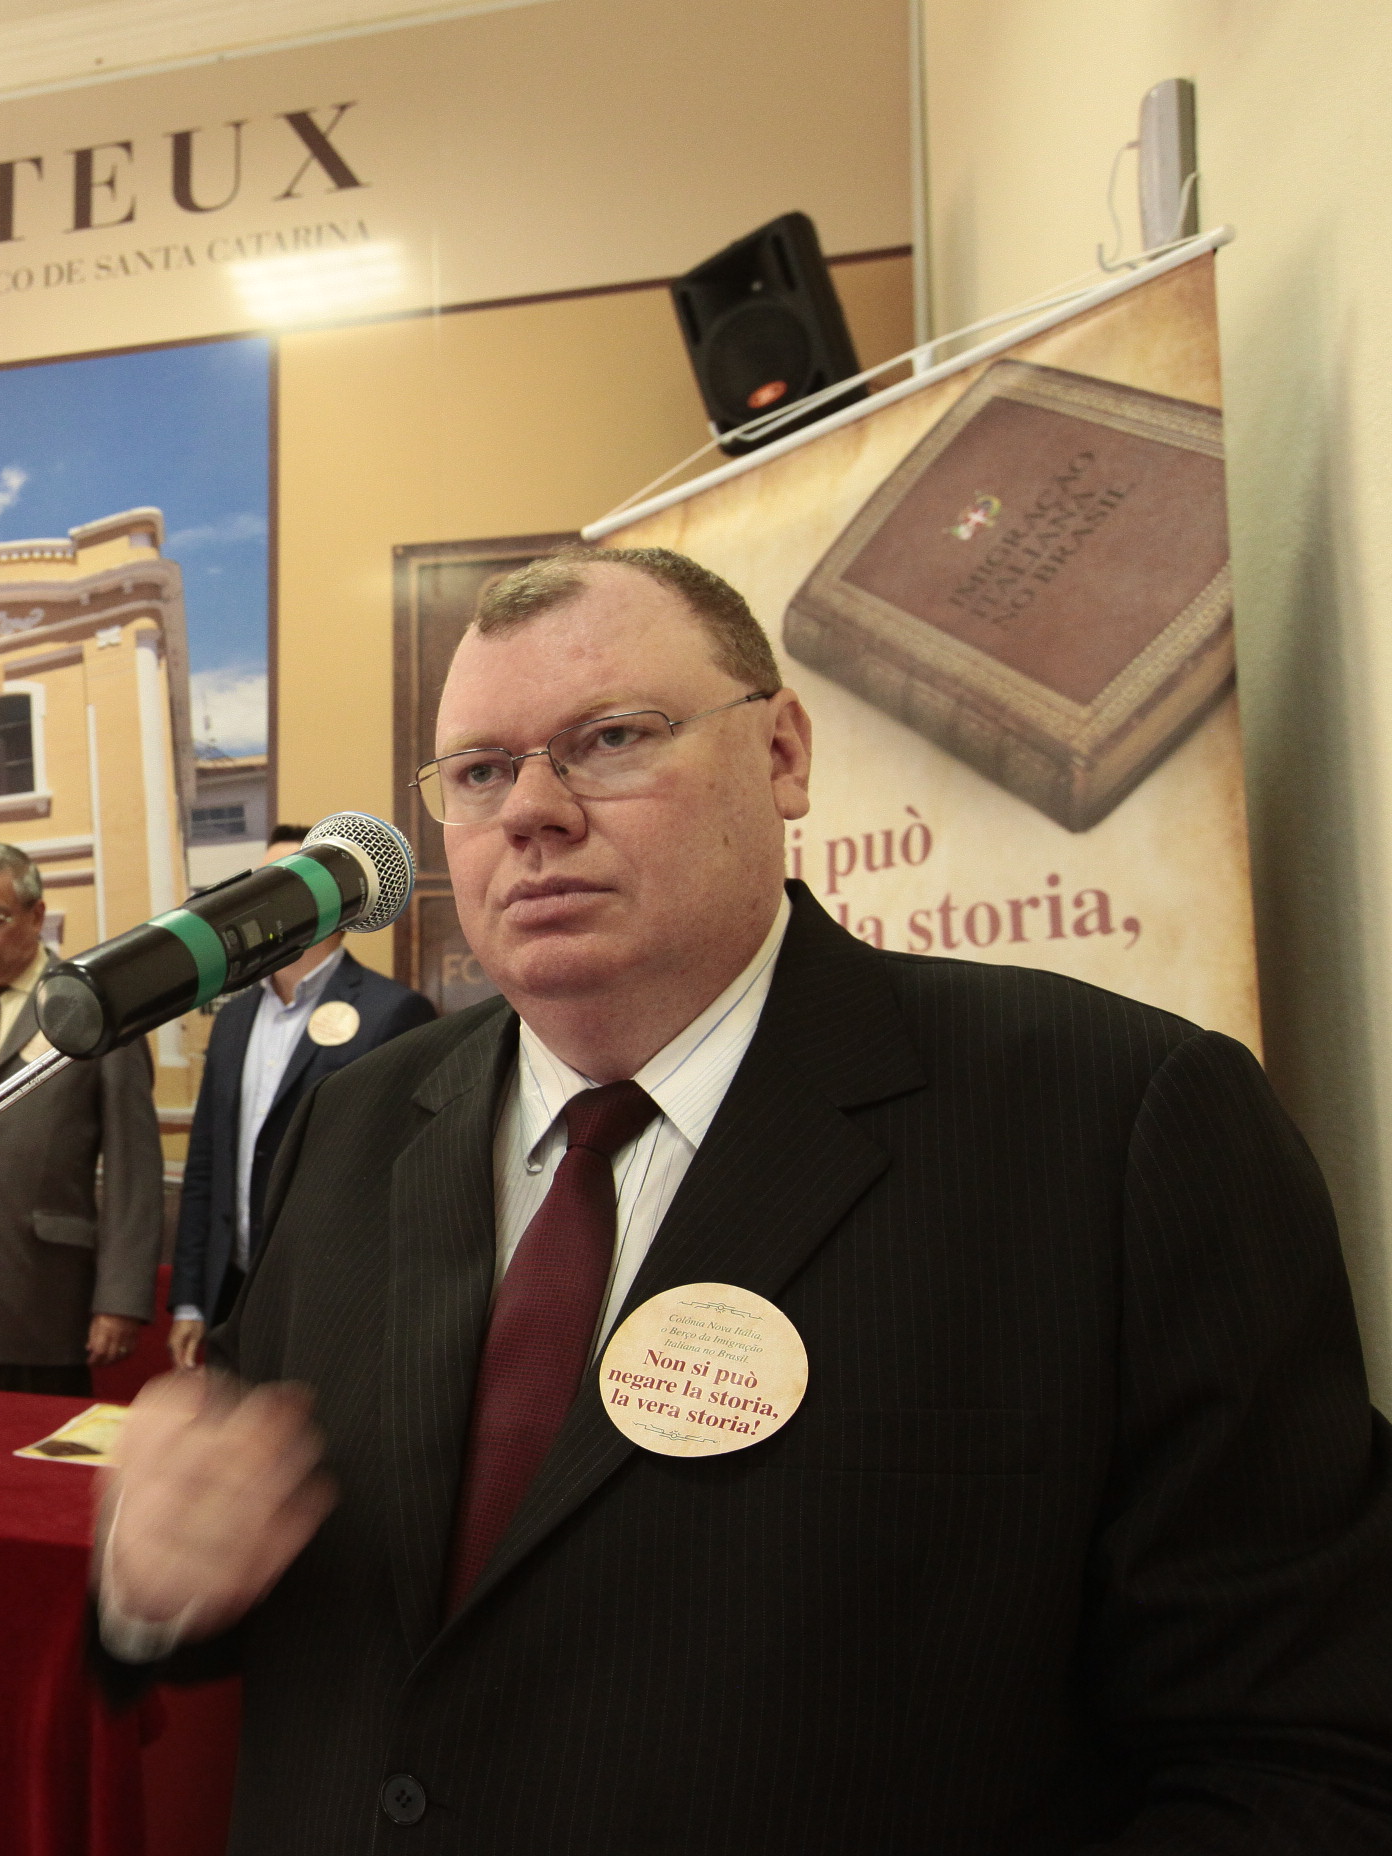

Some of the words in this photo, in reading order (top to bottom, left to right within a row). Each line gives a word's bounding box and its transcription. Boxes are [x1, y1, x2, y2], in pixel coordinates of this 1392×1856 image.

[42, 259, 86, 288] DE
[94, 244, 197, 280] SANTA
[208, 218, 371, 264] CATARINA
[969, 491, 1096, 619] ITALIANA
[824, 805, 934, 896] può
[907, 873, 1142, 954] storia,
[664, 1338, 701, 1354] Italiana
[702, 1348, 716, 1356] no
[668, 1313, 705, 1329] Colônia
[707, 1320, 732, 1334] Nova
[734, 1325, 763, 1341] Itália,
[669, 1326, 697, 1340] Berço
[698, 1332, 712, 1342] da
[713, 1335, 764, 1354] Imigração
[607, 1368, 678, 1393] negare
[681, 1380, 703, 1400] la
[707, 1389, 779, 1420] storia,
[642, 1349, 686, 1373] Non
[690, 1361, 711, 1377] si
[713, 1368, 758, 1389] può
[609, 1388, 630, 1407] la
[637, 1397, 681, 1419] vera
[685, 1409, 762, 1436] storia!
